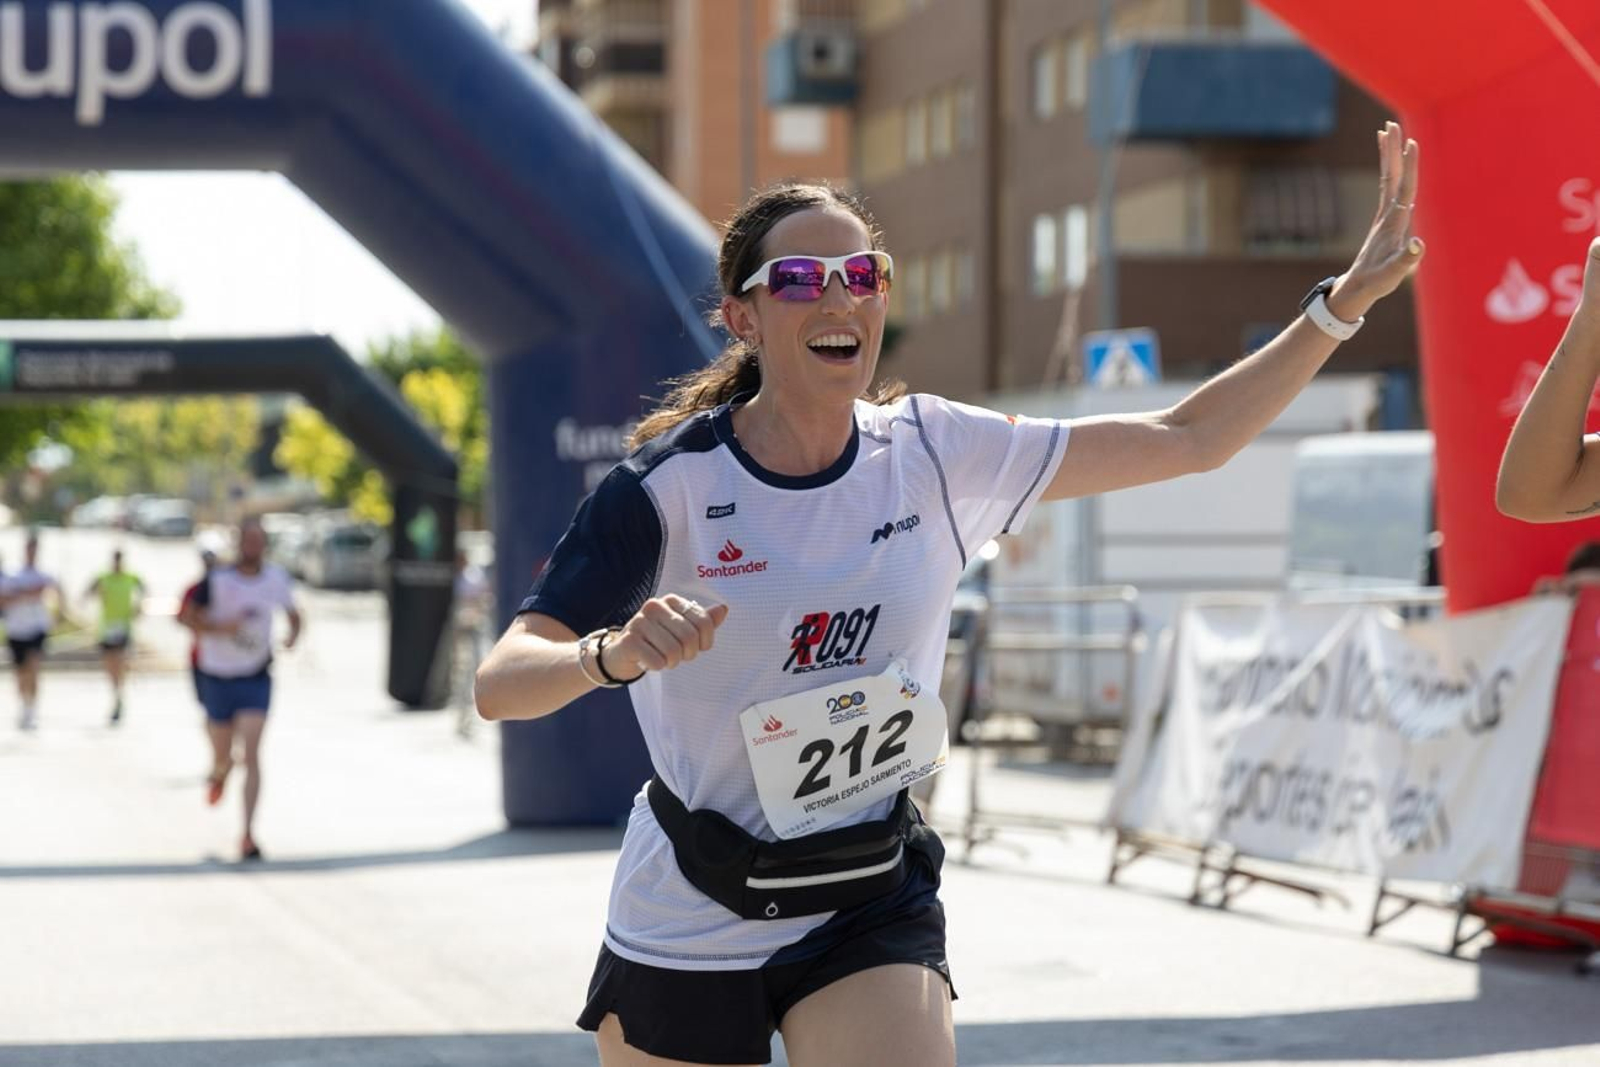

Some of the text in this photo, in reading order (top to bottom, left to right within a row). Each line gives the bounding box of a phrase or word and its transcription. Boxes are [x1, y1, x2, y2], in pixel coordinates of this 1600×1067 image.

[0, 0, 272, 125] upol
[697, 560, 769, 578] Santander
[826, 690, 866, 715] 200
[752, 728, 798, 746] Santander
[793, 709, 914, 800] 212
[803, 758, 912, 814] VICTORIA ESPEJO SARMIENTO
